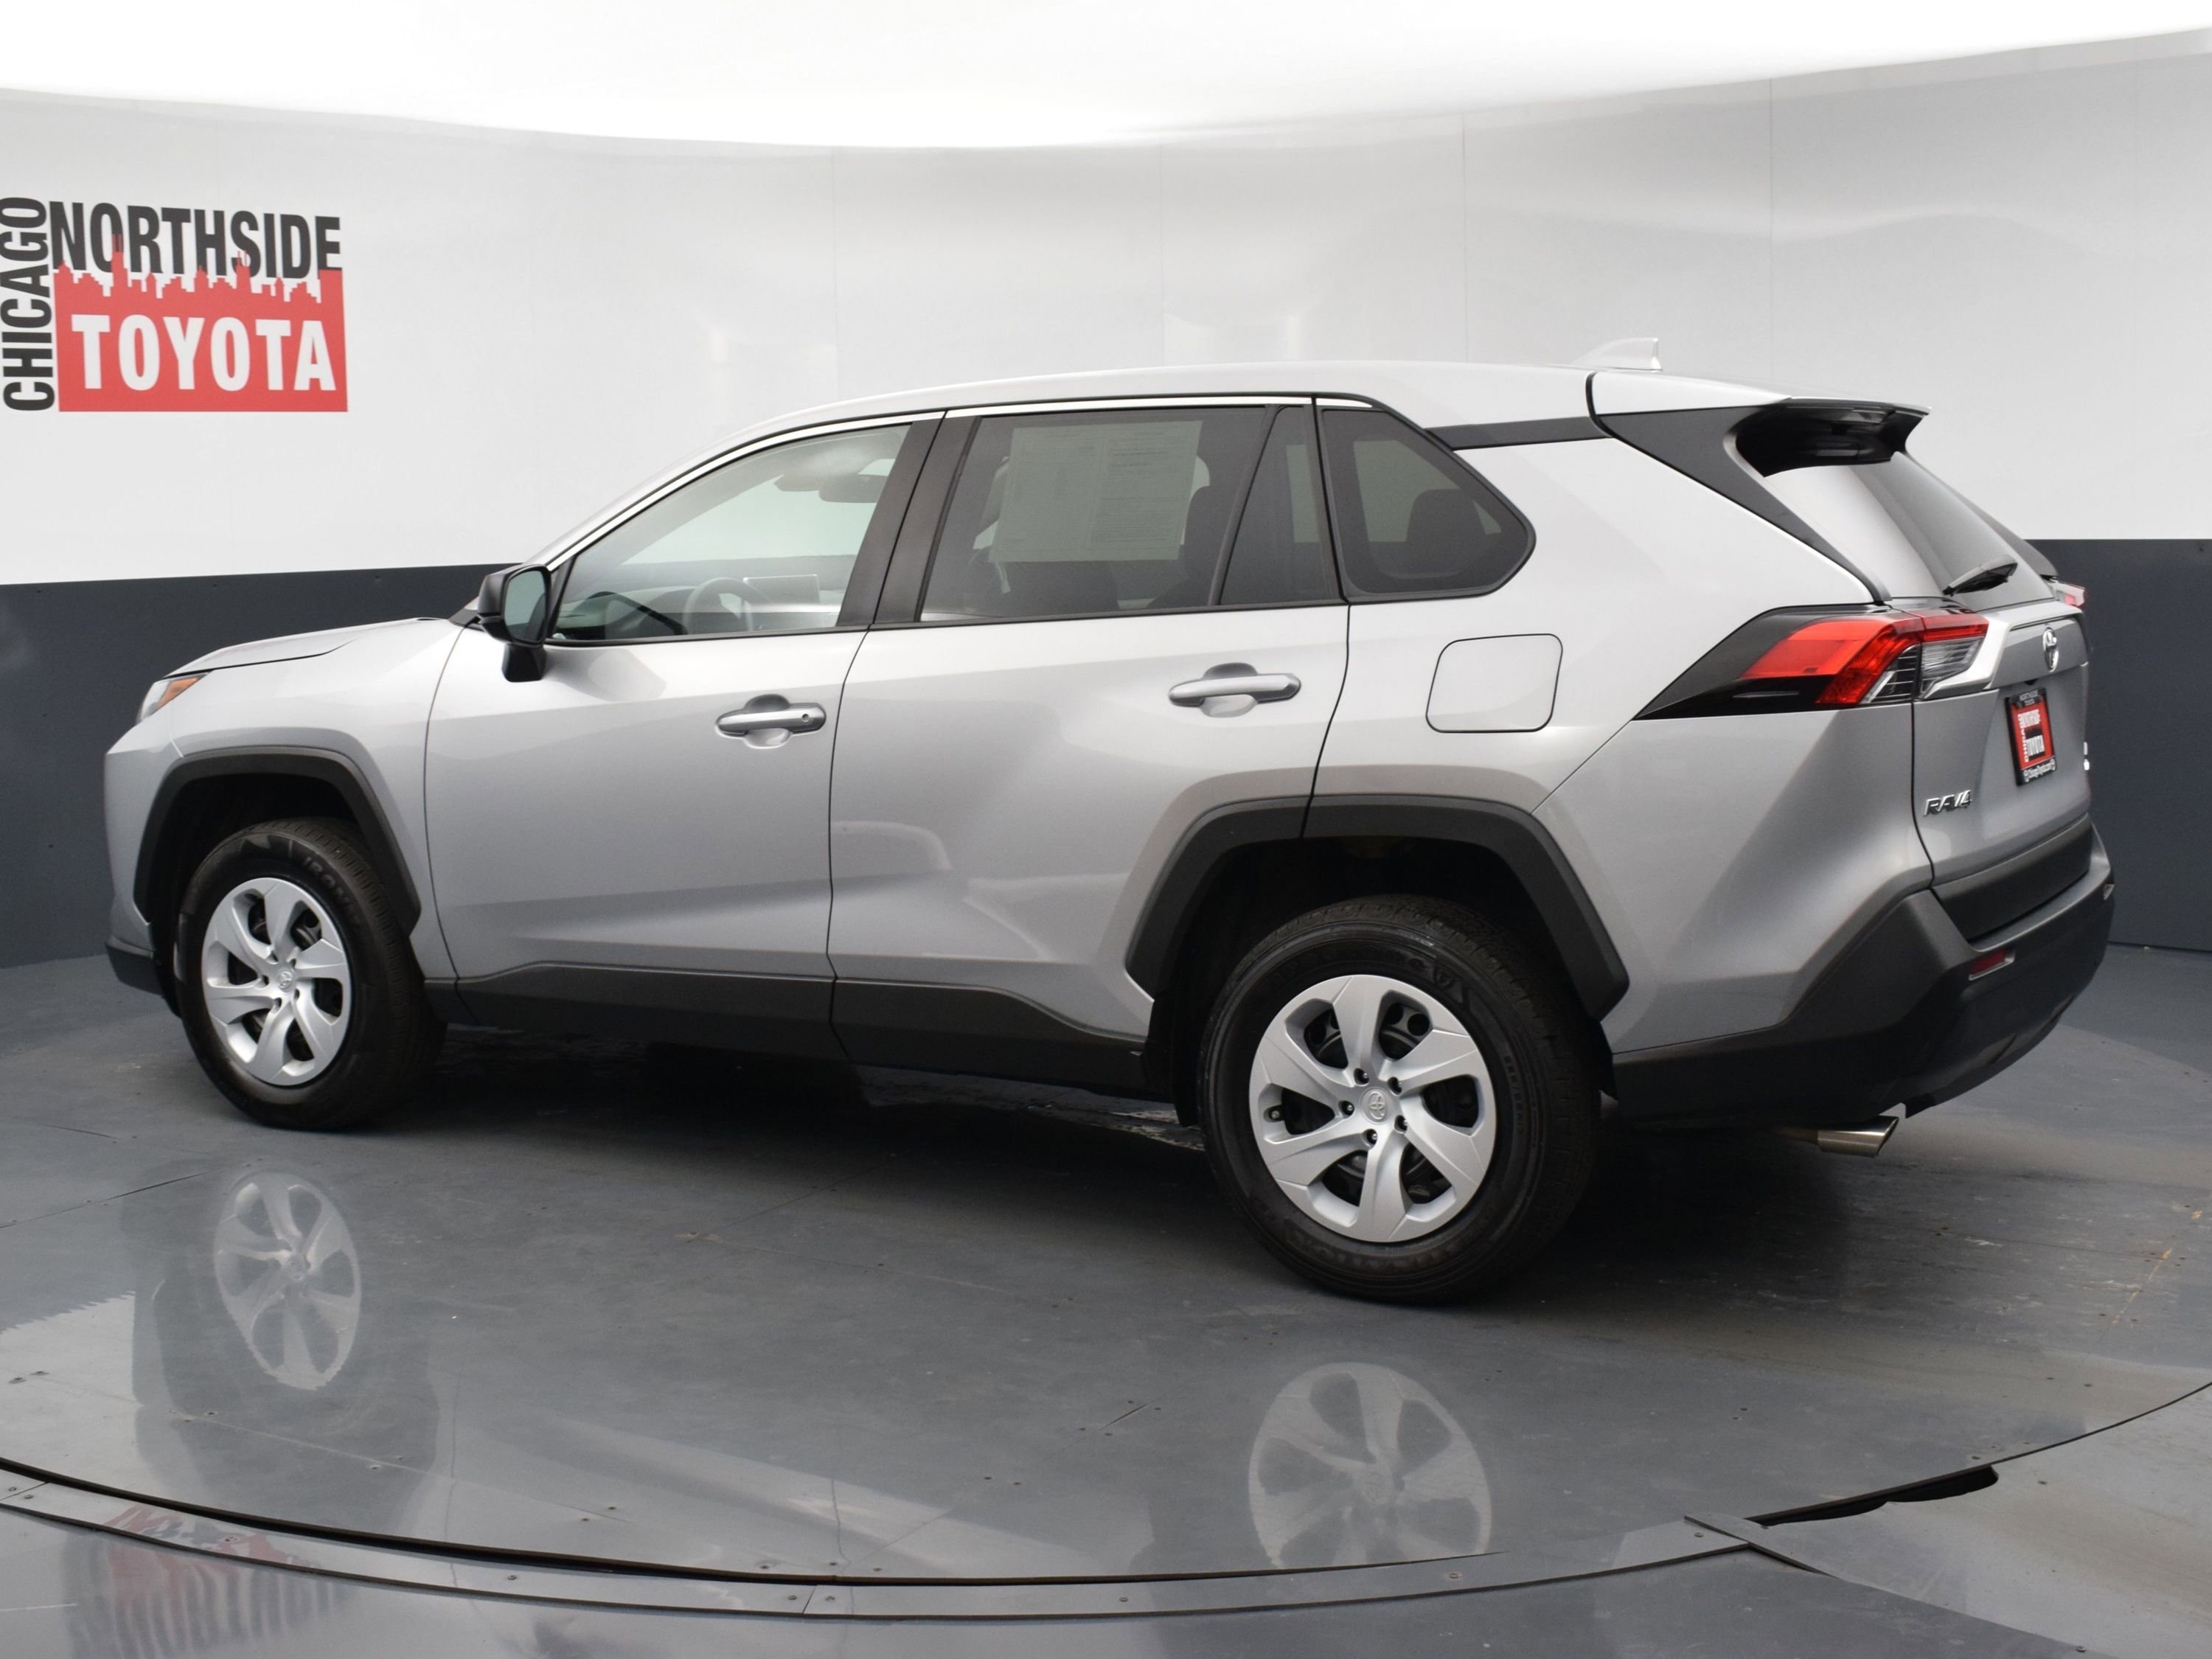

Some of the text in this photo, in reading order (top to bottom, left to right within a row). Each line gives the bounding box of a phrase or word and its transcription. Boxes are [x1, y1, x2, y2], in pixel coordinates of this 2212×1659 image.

[49, 201, 342, 279] NORTHSIDE
[0, 196, 55, 411] CHICAGO
[71, 313, 337, 392] TOYOTA
[1923, 789, 1972, 816] RAV4
